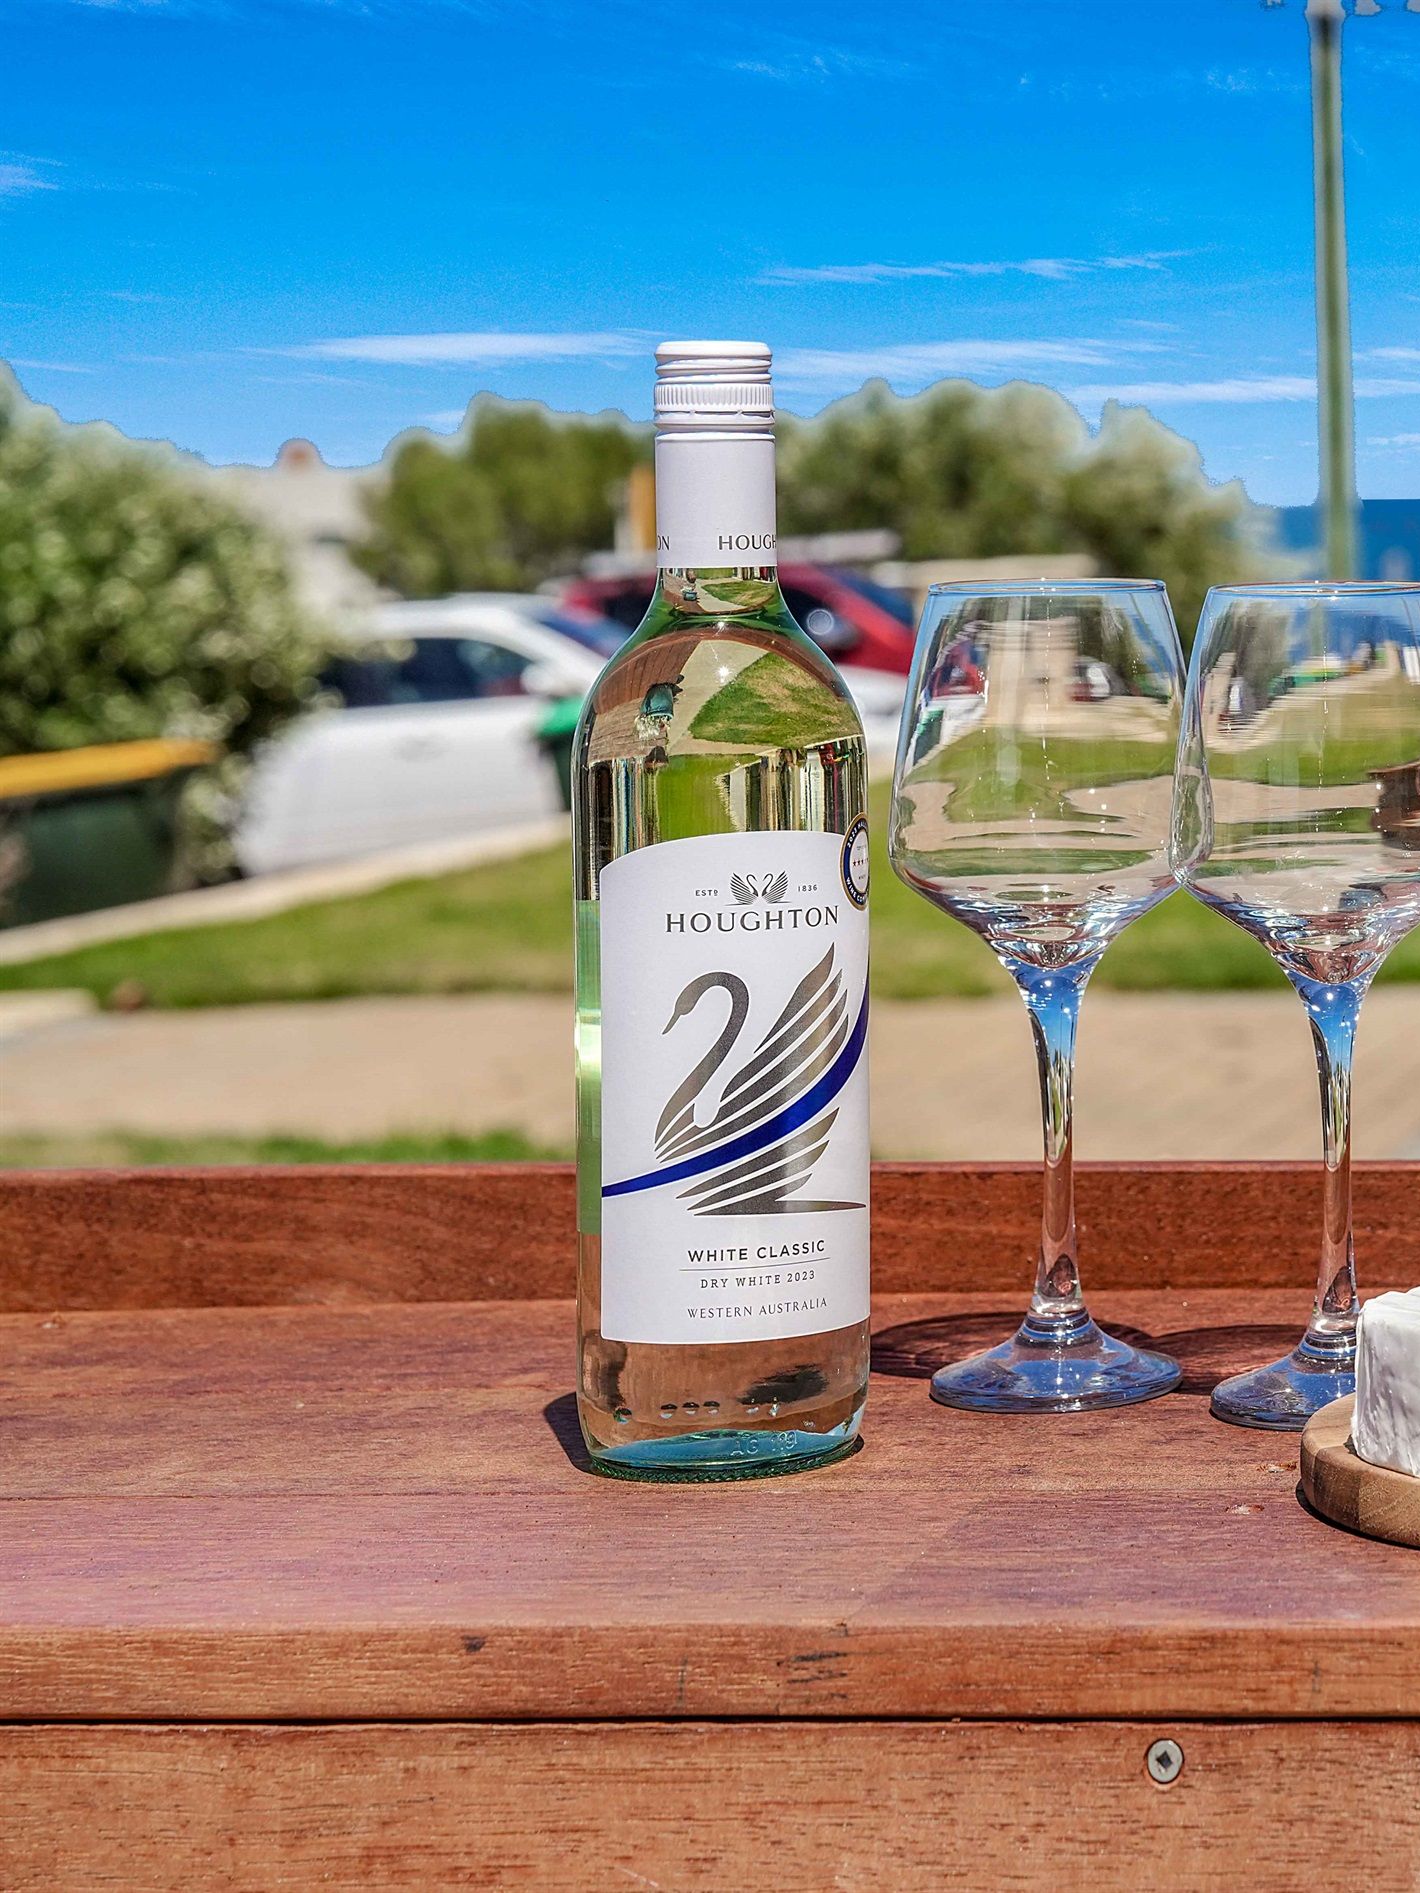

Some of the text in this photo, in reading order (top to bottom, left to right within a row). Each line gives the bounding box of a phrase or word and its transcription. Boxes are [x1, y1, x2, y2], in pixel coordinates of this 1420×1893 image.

[798, 884, 818, 893] 1836
[665, 905, 839, 933] HOUGHTON
[688, 1240, 826, 1262] WHITE CLASSIC
[701, 1270, 815, 1289] DRY WHITE 2023
[687, 1297, 828, 1319] WESTERN AUSTRALIA
